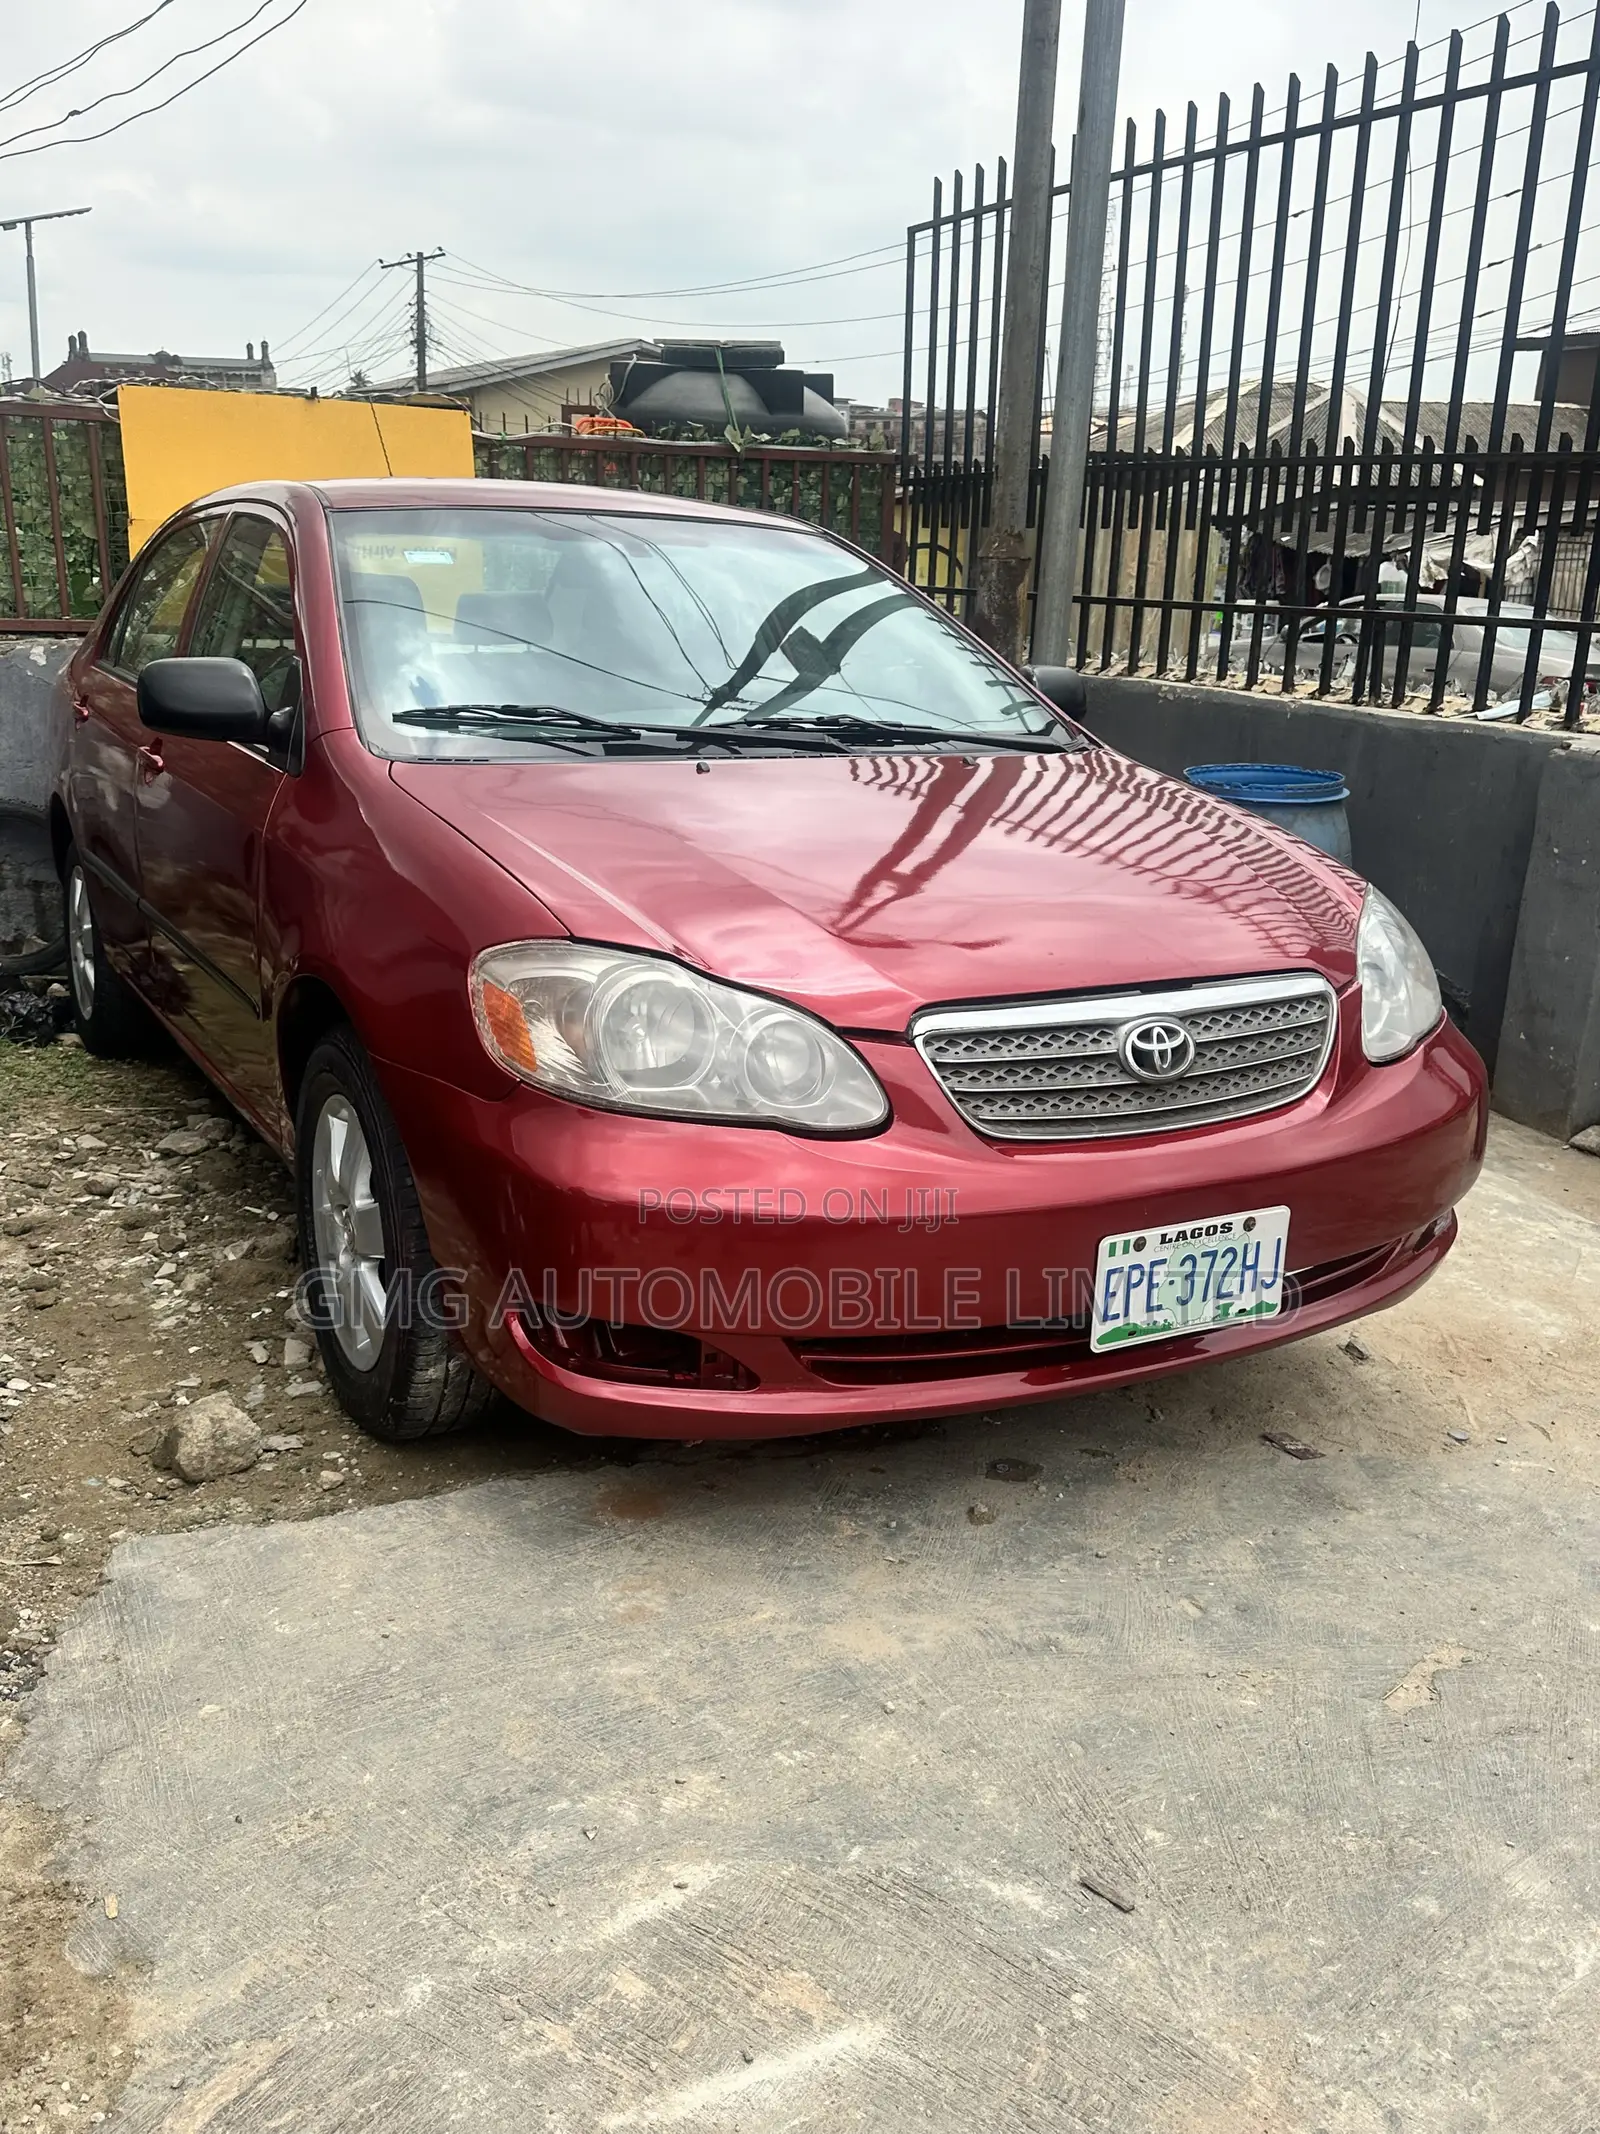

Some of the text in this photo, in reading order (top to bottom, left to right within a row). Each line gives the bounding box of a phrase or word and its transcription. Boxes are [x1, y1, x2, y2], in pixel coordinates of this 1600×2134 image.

[1153, 1242, 1181, 1253] CENTRE
[1193, 1232, 1237, 1246] EXCELLENCE
[1159, 1222, 1234, 1245] LAGOS
